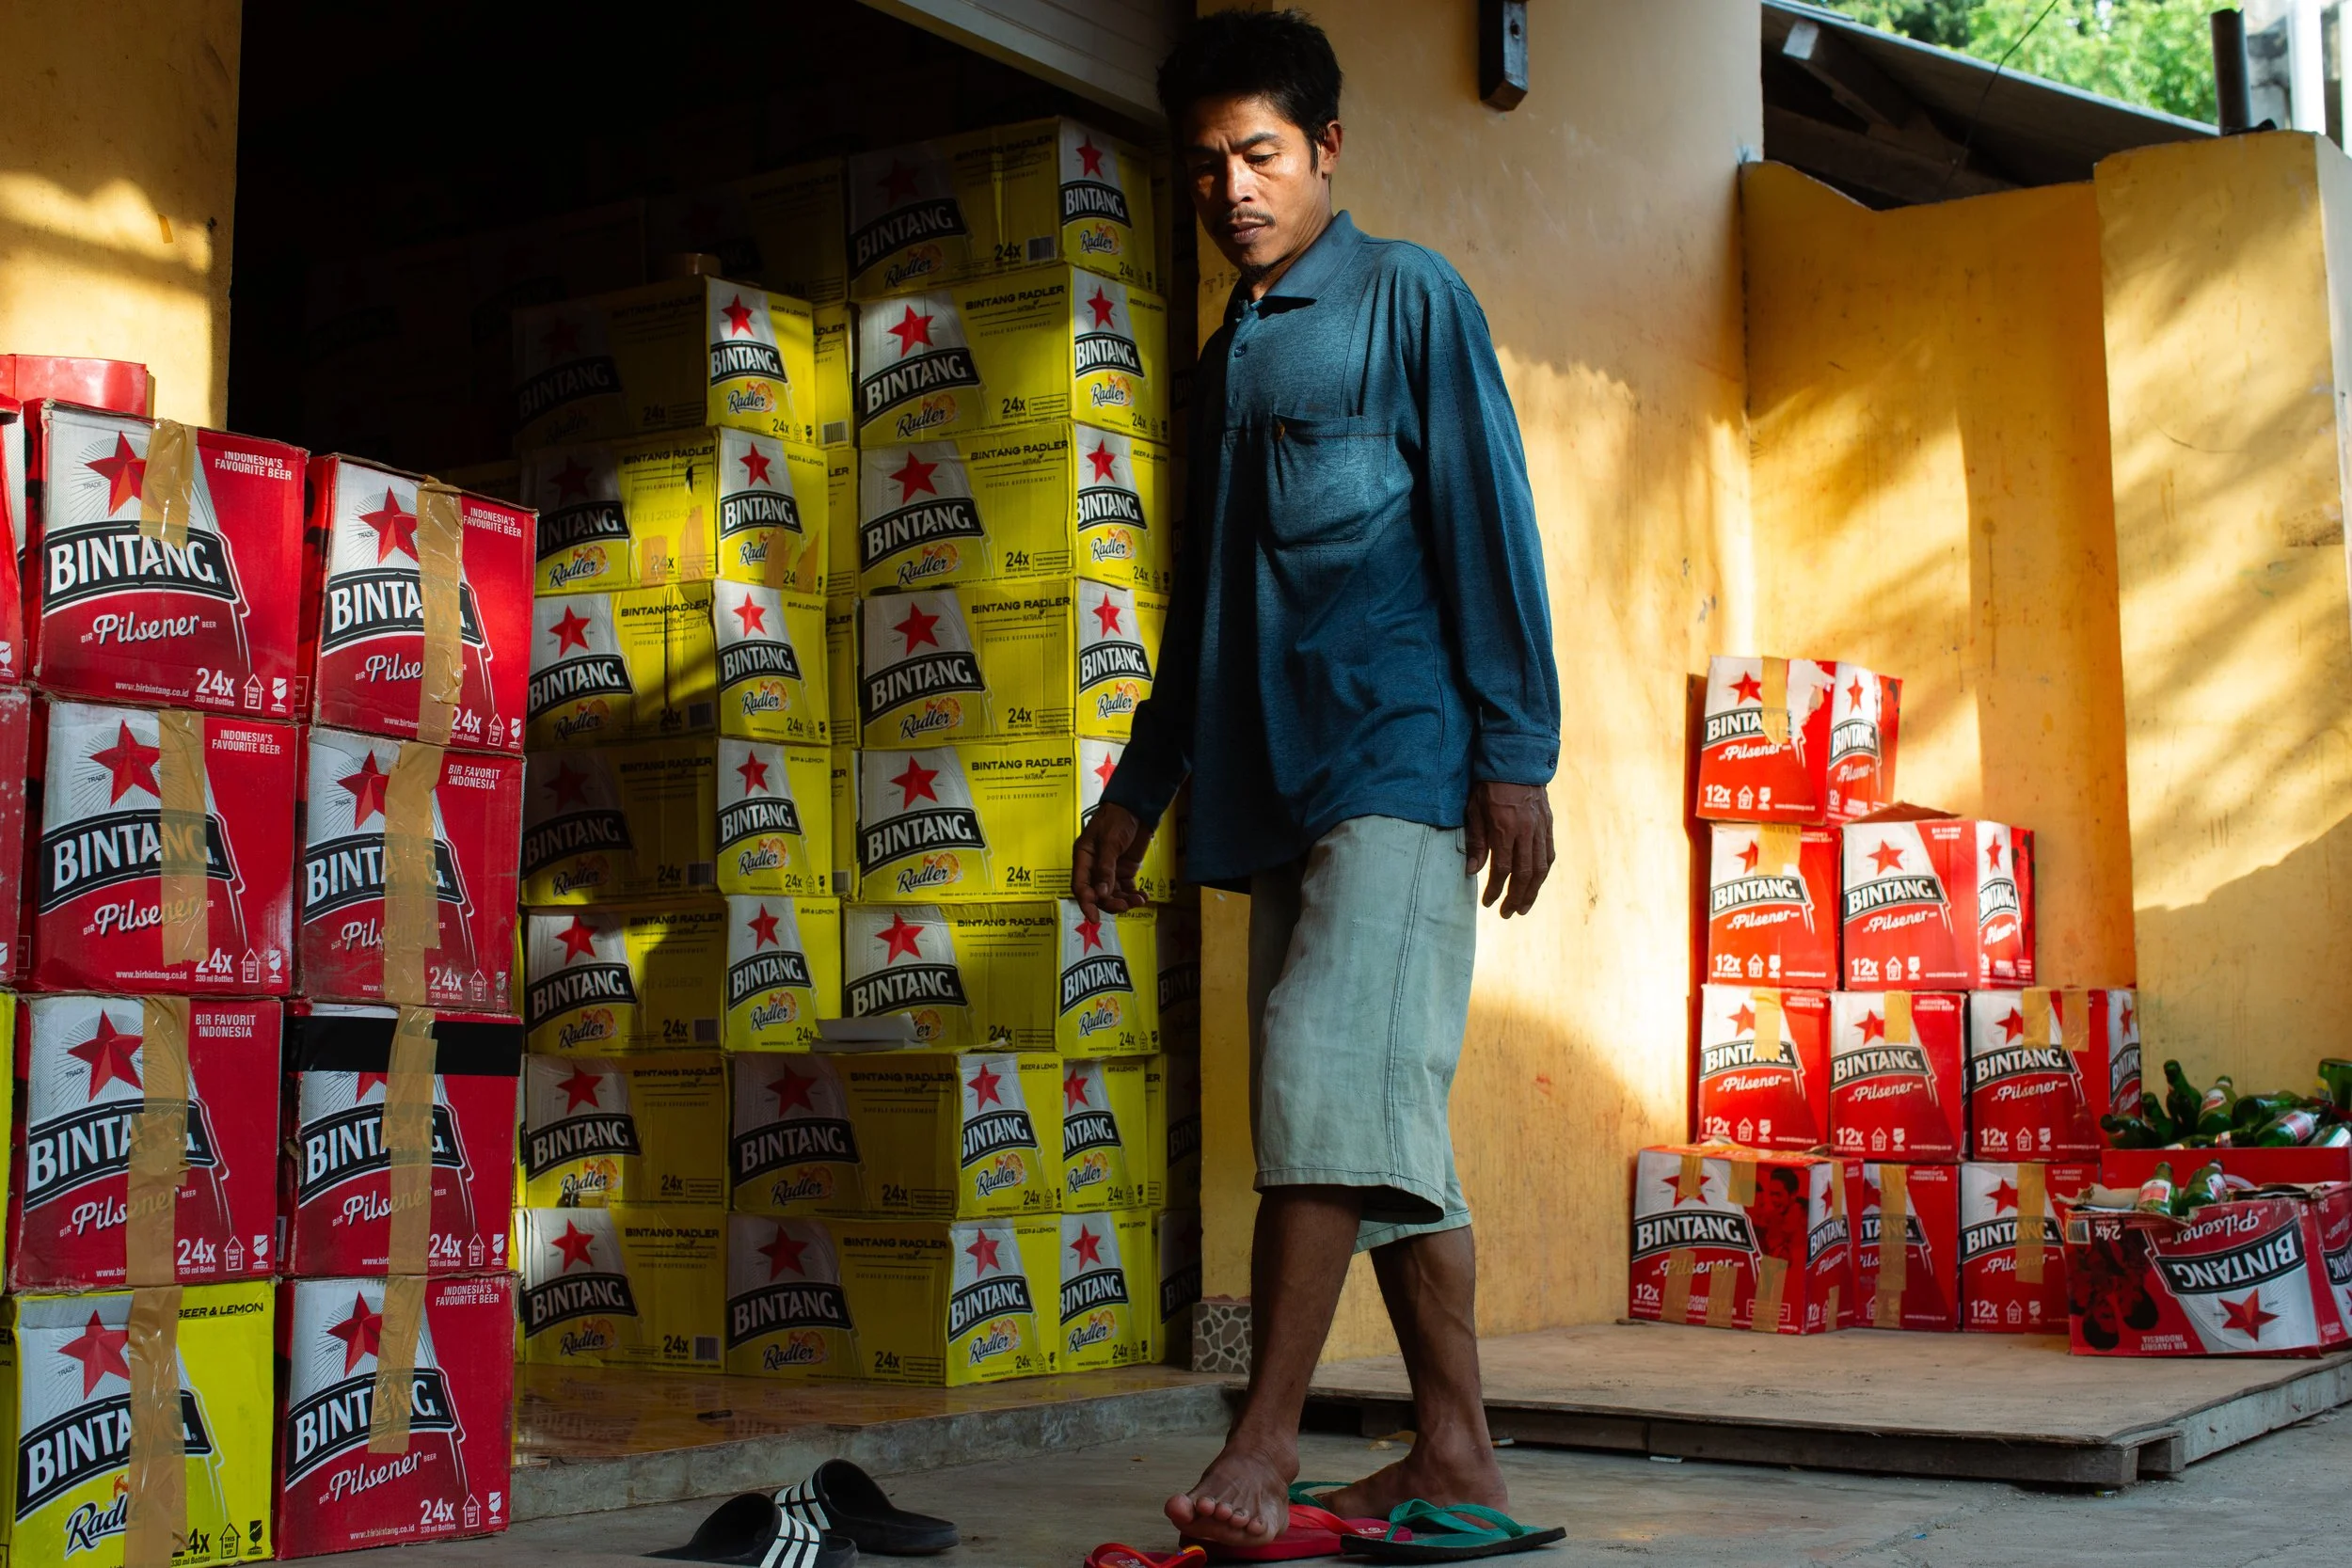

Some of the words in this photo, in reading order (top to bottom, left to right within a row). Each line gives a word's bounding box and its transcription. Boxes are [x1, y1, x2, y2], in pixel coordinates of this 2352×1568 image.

[1065, 187, 1125, 218] BINTANG
[856, 204, 955, 268] BINTANG
[965, 293, 1016, 310] BINTANG
[1019, 285, 1065, 301] RADLER
[711, 346, 778, 376] BINTANG
[1074, 339, 1136, 370] BINTANG
[866, 355, 967, 415] BINTANG
[1090, 382, 1125, 407] Radler
[728, 389, 766, 415] Radler
[1002, 396, 1025, 415] 24x
[896, 405, 946, 439] Radler
[224, 451, 283, 468] INDONESIA'S
[970, 447, 1021, 461] BINTANG
[1024, 440, 1070, 453] RADLER
[215, 459, 264, 477] FAVOURITE
[267, 467, 292, 481] BEER
[83, 481, 103, 489] TRADE
[470, 507, 516, 527] INDONESIA'S
[724, 497, 794, 530] BINTANG
[1077, 493, 1139, 524] BINTANG
[463, 516, 502, 533] FAVOURITE
[503, 527, 522, 538] BEER
[539, 507, 620, 552] INTANG
[866, 504, 972, 562] BINTANG
[1005, 551, 1030, 568] 24x
[1091, 537, 1126, 562] Radler
[49, 534, 216, 595] BINTANG
[897, 555, 947, 586] Radler
[1134, 566, 1149, 581] 24x
[971, 602, 1021, 614] BINTANG
[1024, 596, 1071, 610] RADLER
[81, 633, 93, 643] BIR
[93, 611, 200, 645] Pilsener
[723, 646, 792, 682] BINTANG
[1081, 646, 1145, 685] BINTANG
[115, 682, 189, 698] www.birbintang.co.id
[196, 668, 234, 697] 24x
[529, 661, 621, 714] BINTANG
[871, 658, 974, 713] BINTANG
[195, 695, 206, 704] 330
[215, 697, 234, 706] Bottles
[741, 690, 779, 716] Radler
[1098, 693, 1133, 719] Radler
[452, 706, 481, 735] 24x
[787, 717, 803, 733] 24x
[900, 709, 950, 741] Radler
[1008, 707, 1032, 724] 24x
[212, 739, 258, 753] FAVOURITE
[260, 744, 280, 754] BEER
[220, 729, 274, 744] INDONESIA'S
[1832, 725, 1876, 759] BINTANG
[972, 759, 1023, 771] BINTANG
[1025, 757, 1072, 768] RADLER
[1724, 742, 1783, 761] Pilsener
[448, 764, 462, 777] BIR
[464, 767, 501, 780] FAVORIT
[448, 775, 496, 790] INDONESIA
[1705, 784, 1732, 802] 12x
[721, 803, 793, 844] BINTANG
[867, 814, 973, 866] BINTANG
[53, 822, 215, 893] BINTANG
[738, 848, 778, 876] Radler
[305, 847, 452, 908] BINTAG
[785, 874, 803, 888] 24x
[898, 864, 949, 895] Radler
[1007, 866, 1031, 882] 24x
[1713, 878, 1797, 911] BINTANG
[1847, 879, 1935, 915] BINTANG
[94, 899, 196, 937] Pilsener
[1732, 909, 1792, 929] Pilsener
[1868, 909, 1928, 933] Pilsener
[195, 947, 232, 974] 24x
[1715, 954, 1741, 973] 12x
[1851, 957, 1879, 976] 12x
[116, 970, 187, 981] www.birbintang.co.id
[429, 966, 463, 992] 24x
[733, 958, 803, 1000] BINTANG
[1064, 961, 1125, 1006] BINTANG
[533, 970, 626, 1021] BINTANG
[851, 971, 955, 1018] BINTANG
[195, 1014, 213, 1026] BIR
[215, 1014, 256, 1026] FAVORIT
[663, 1019, 688, 1037] 24x
[751, 1004, 788, 1031] Radler
[1079, 1009, 1113, 1037] Radler
[199, 1026, 252, 1037] INDONESIA
[1120, 1032, 1136, 1047] 24x
[1834, 1050, 1919, 1083] BINTANG
[1975, 1048, 2063, 1082] BINTANG
[1724, 1074, 1782, 1093] Pilsener
[1854, 1082, 1914, 1102] Pilsener
[1997, 1079, 2058, 1102] Pilsener
[1705, 1116, 1730, 1134] 12x
[1836, 1127, 1864, 1147] 12x
[1980, 1128, 2008, 1147] 12x
[27, 1113, 197, 1193] BINTA
[306, 1117, 445, 1185] BINTAG
[532, 1120, 630, 1170] BINTANG
[739, 1126, 847, 1175] BINTANG
[976, 1165, 1016, 1196] Radler
[1068, 1166, 1102, 1194] Radler
[182, 1190, 197, 1199] BEER
[1024, 1189, 1041, 1206] 24x
[1107, 1186, 1123, 1202] 24x
[1637, 1215, 1745, 1252] BINTANG
[1810, 1219, 1847, 1258] BINTANG
[2095, 1220, 2122, 1241] 24x
[2174, 1213, 2259, 1243] Pilsener
[177, 1237, 216, 1265] 24x
[429, 1233, 462, 1259] 24x
[2174, 1226, 2298, 1289] BINTANG
[179, 1267, 189, 1275] 330
[199, 1265, 215, 1275] Botol
[436, 1295, 478, 1307] FAVOURITE
[479, 1293, 500, 1304] BEER
[444, 1284, 492, 1295] INDONESIA'S
[1635, 1283, 1660, 1302] 12x
[178, 1306, 207, 1319] BEER
[210, 1306, 218, 1316] &
[220, 1302, 264, 1315] LEMON
[531, 1281, 625, 1326] BINTANG
[734, 1291, 839, 1339] BINTANG
[951, 1281, 1025, 1333] BINTANG
[1971, 1299, 1998, 1318] 12x
[663, 1335, 689, 1354] 24x
[968, 1332, 1009, 1367] Radler
[1068, 1322, 1107, 1354] Radler
[875, 1351, 900, 1369] 24x
[294, 1380, 436, 1465] BINTNG
[26, 1407, 193, 1498] BINTAG
[329, 1450, 422, 1502] Pilsener
[423, 1453, 437, 1462] BEER
[420, 1497, 454, 1525] 24x
[65, 1495, 128, 1560] Radl
